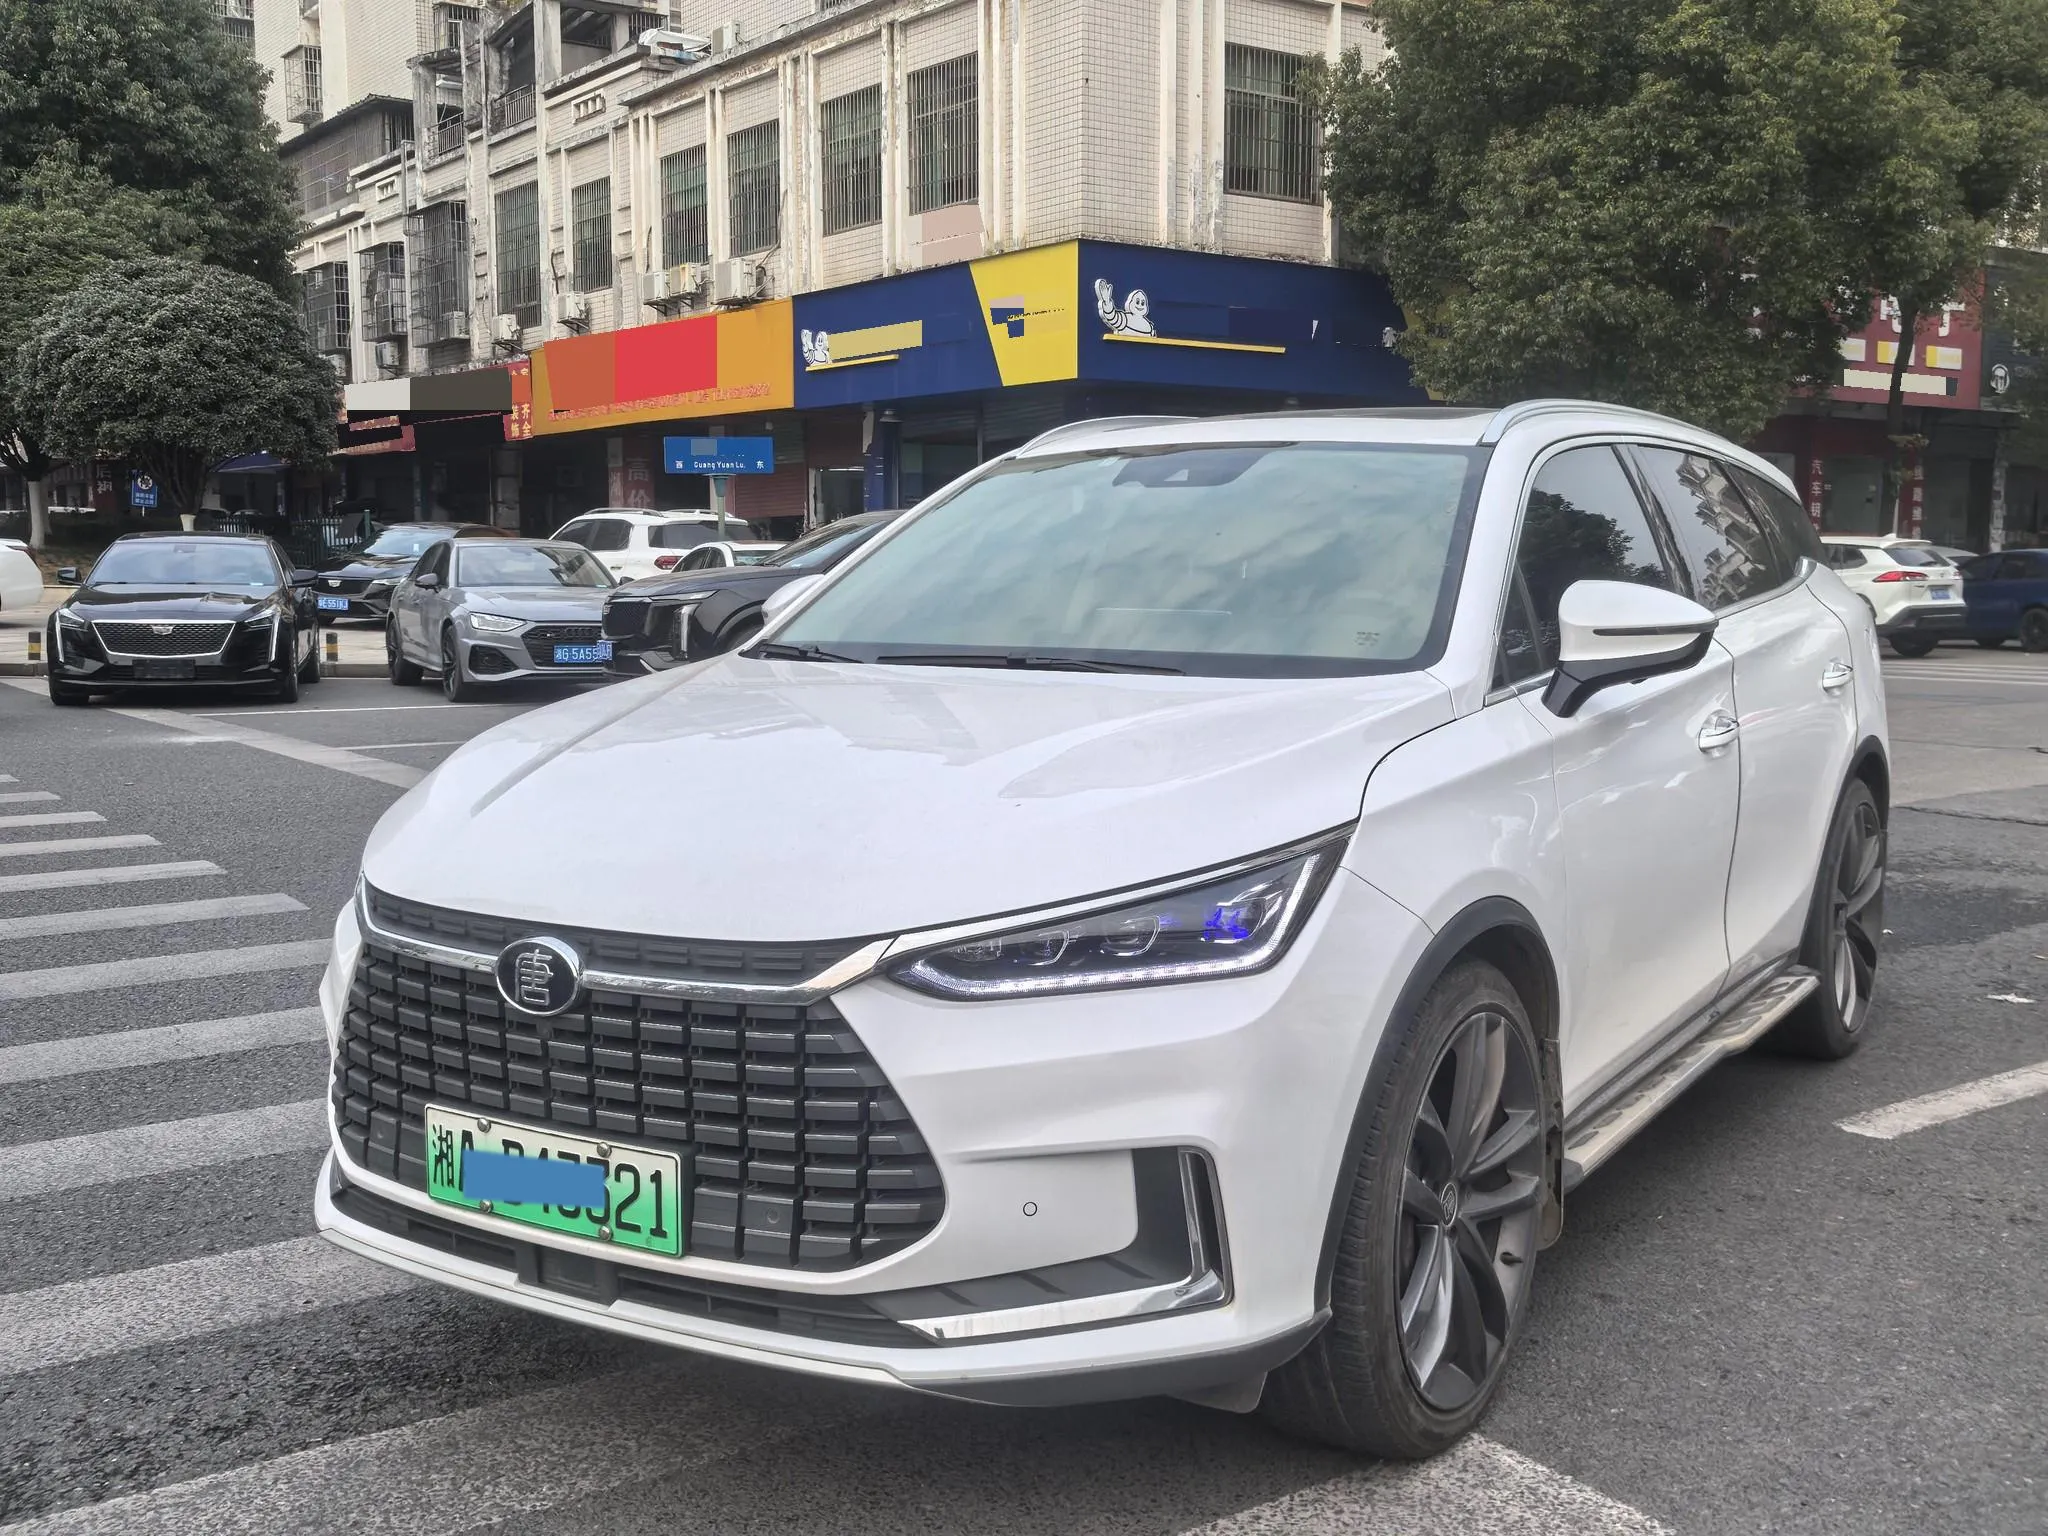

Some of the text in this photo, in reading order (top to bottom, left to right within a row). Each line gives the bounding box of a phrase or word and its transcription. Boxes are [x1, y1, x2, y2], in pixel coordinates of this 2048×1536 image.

[693, 461, 715, 470] Guang
[716, 461, 734, 469] Yuan
[756, 460, 765, 469] 东
